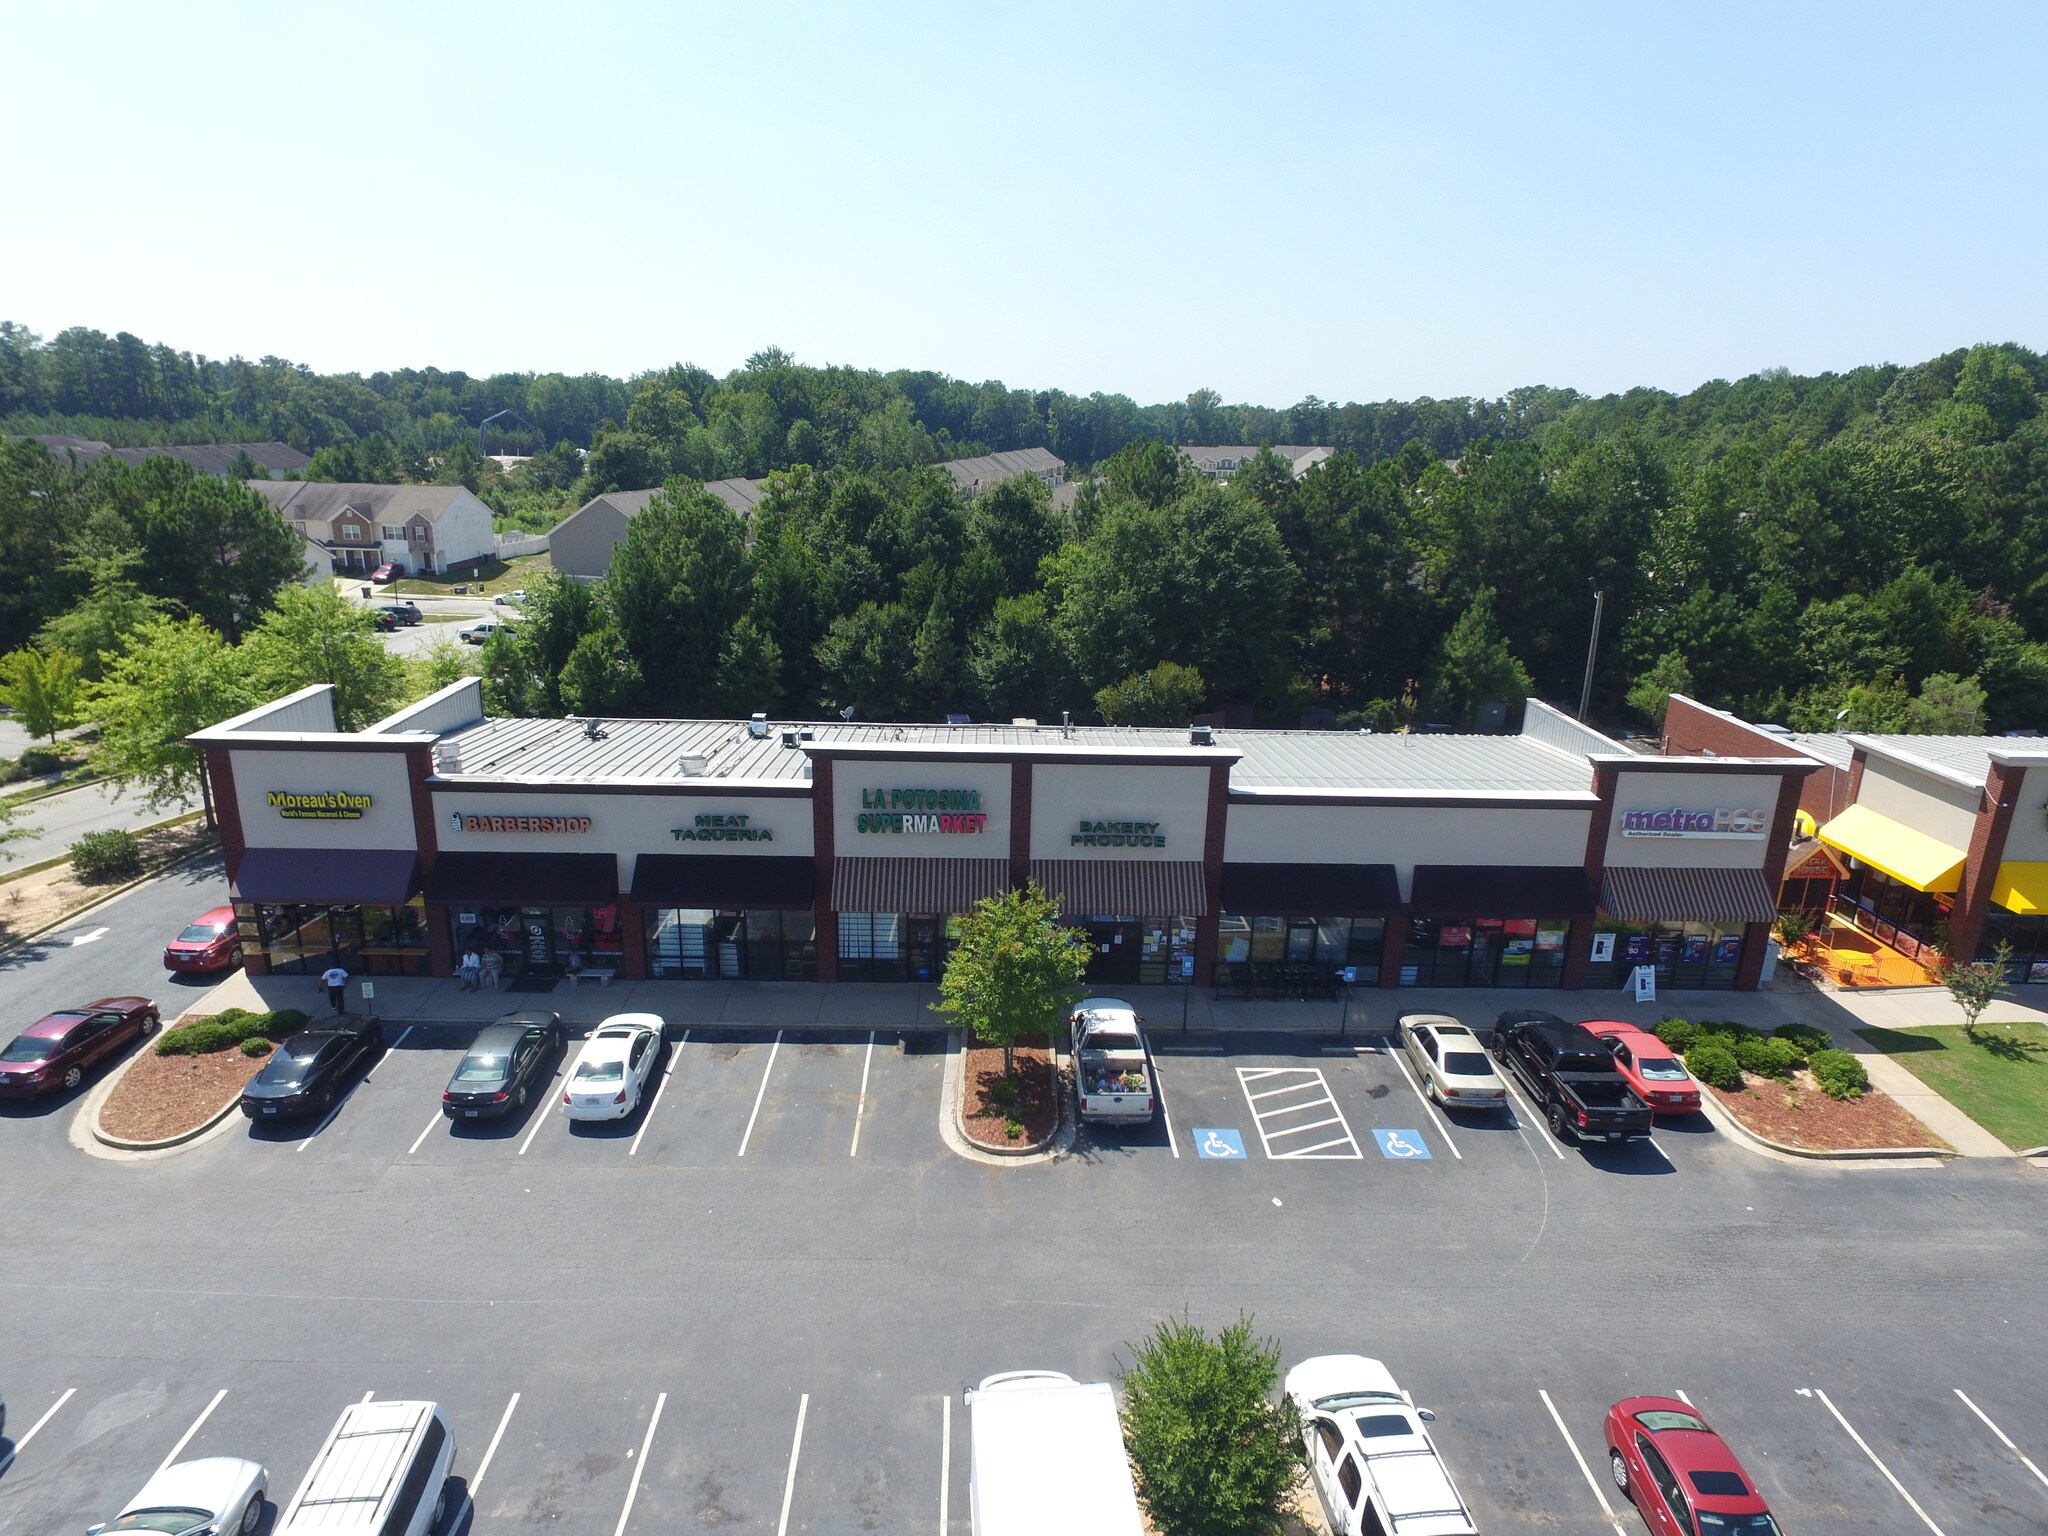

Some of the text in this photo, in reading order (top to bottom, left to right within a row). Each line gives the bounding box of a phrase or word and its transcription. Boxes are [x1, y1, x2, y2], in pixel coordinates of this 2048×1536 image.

[267, 790, 372, 809] Moreau's Oven
[862, 788, 980, 811] LA POTOSINA
[281, 810, 298, 818] World's
[299, 810, 317, 818] Famous
[317, 810, 338, 818] Macaroni
[694, 815, 749, 828] MEAT
[1622, 807, 1768, 832] metroPCS
[466, 815, 591, 833] BARBERSHOP
[857, 813, 987, 834] SUPERMARKET
[1079, 821, 1160, 834] BAKERY
[670, 829, 773, 842] TAQUERIA
[1070, 835, 1166, 848] PRODUCE
